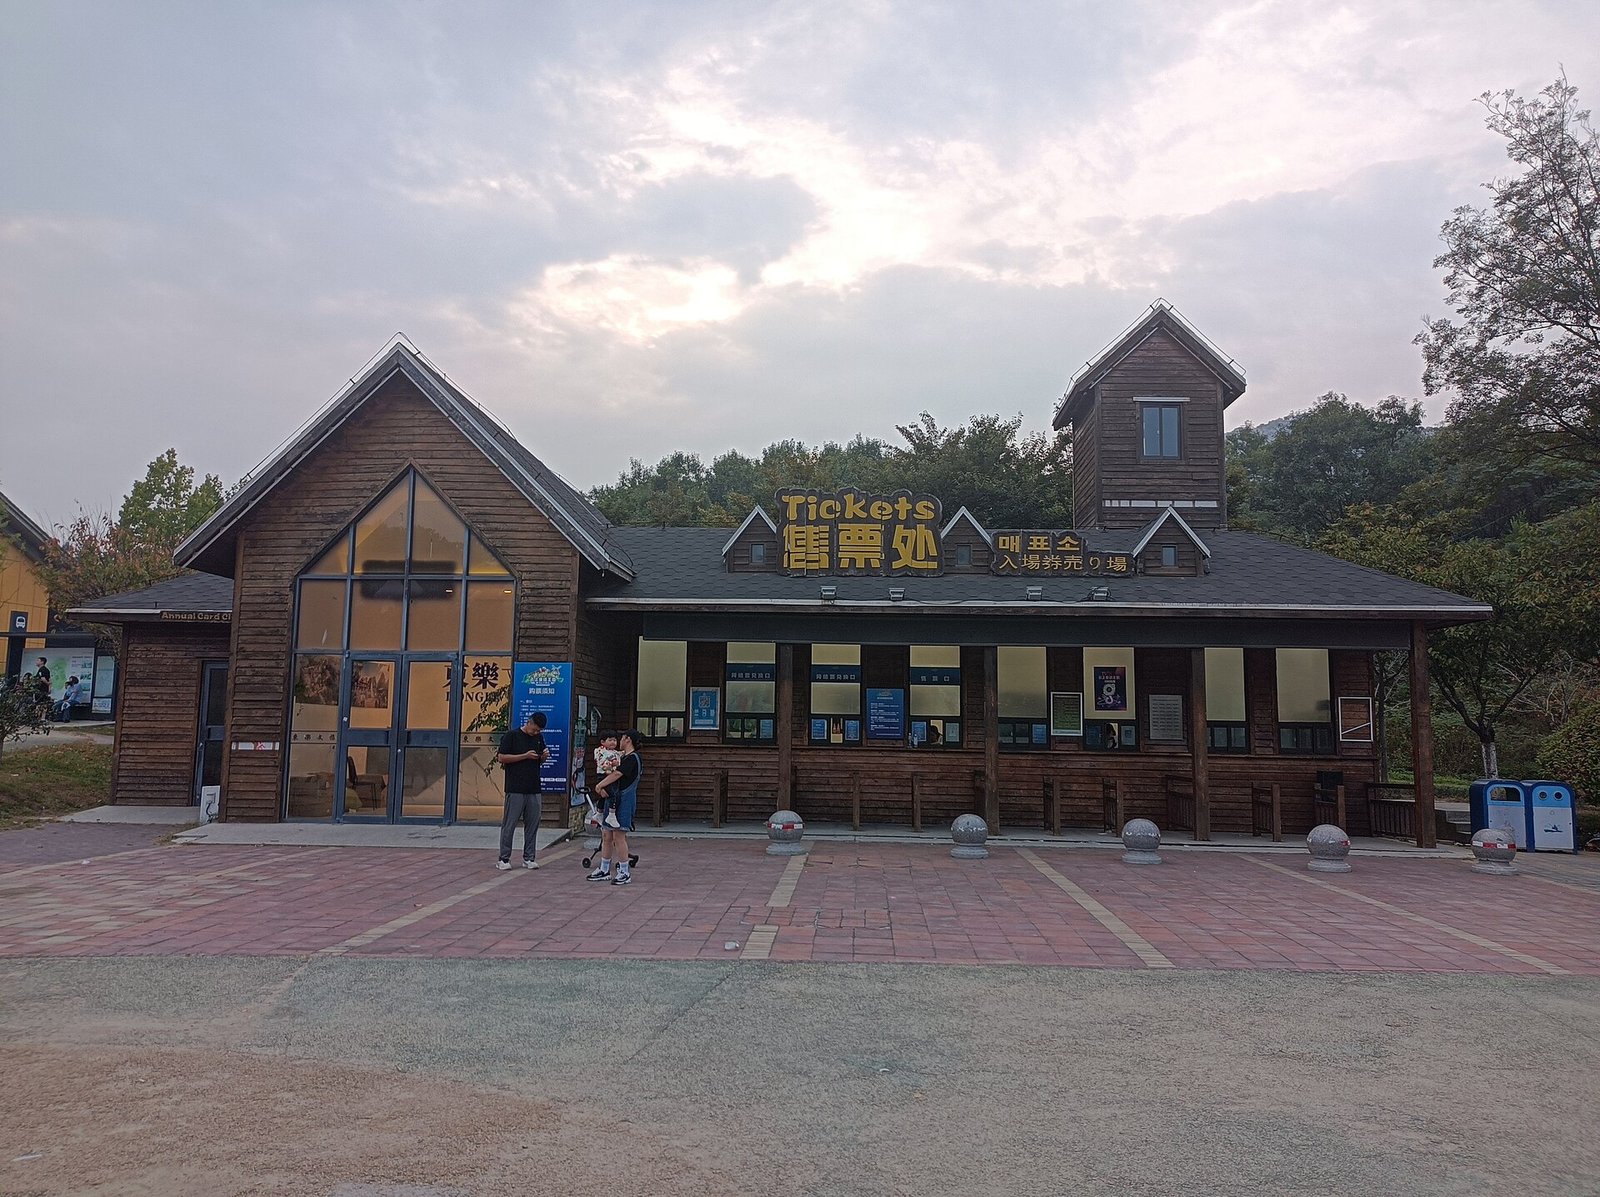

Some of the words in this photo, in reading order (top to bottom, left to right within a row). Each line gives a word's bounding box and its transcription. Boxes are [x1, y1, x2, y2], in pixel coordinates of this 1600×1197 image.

[782, 493, 935, 521] Tickets
[783, 523, 938, 570] 售票处
[998, 535, 1080, 553] 매표소
[999, 553, 1127, 572] 入場券売り場
[162, 612, 196, 620] Annual
[197, 612, 220, 620] Card
